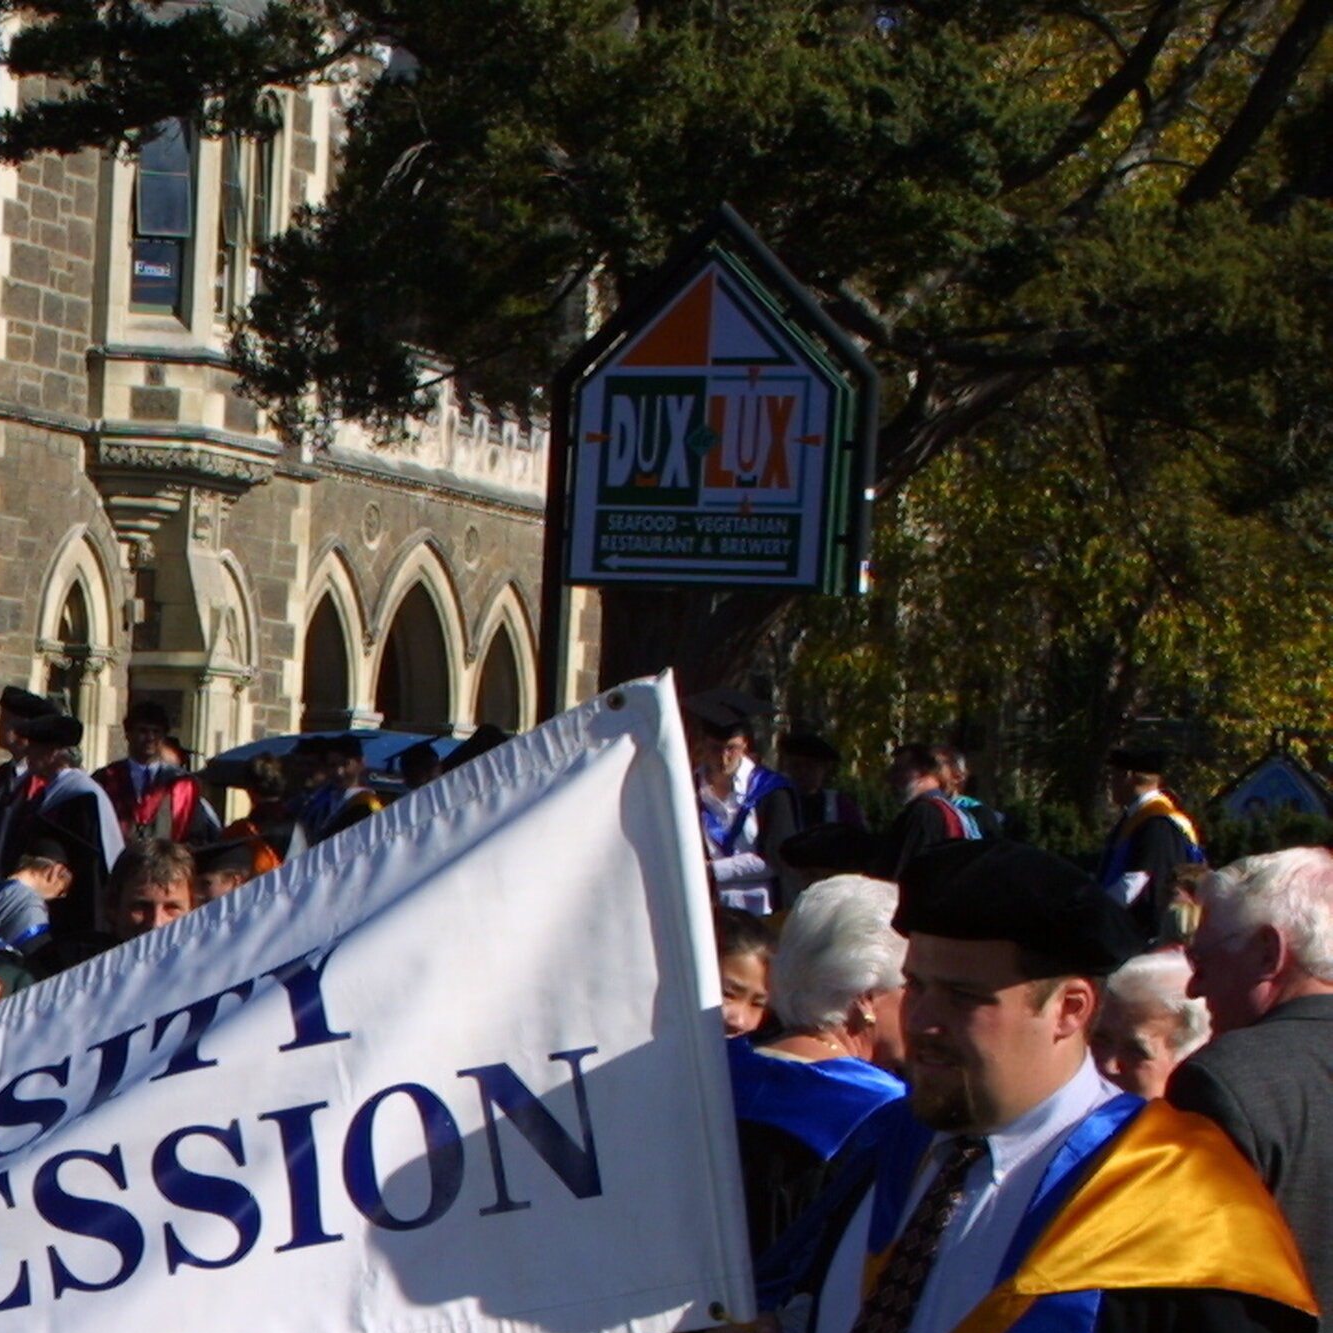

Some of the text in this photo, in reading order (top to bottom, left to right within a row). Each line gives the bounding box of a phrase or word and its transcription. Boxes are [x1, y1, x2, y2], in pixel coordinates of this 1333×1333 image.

[605, 393, 698, 488] DUX
[703, 395, 796, 489] LUX
[607, 514, 677, 532] SEAFOOD
[694, 516, 789, 534] VEGETARIAN
[600, 534, 792, 554] RESTAURANT & BREWERY
